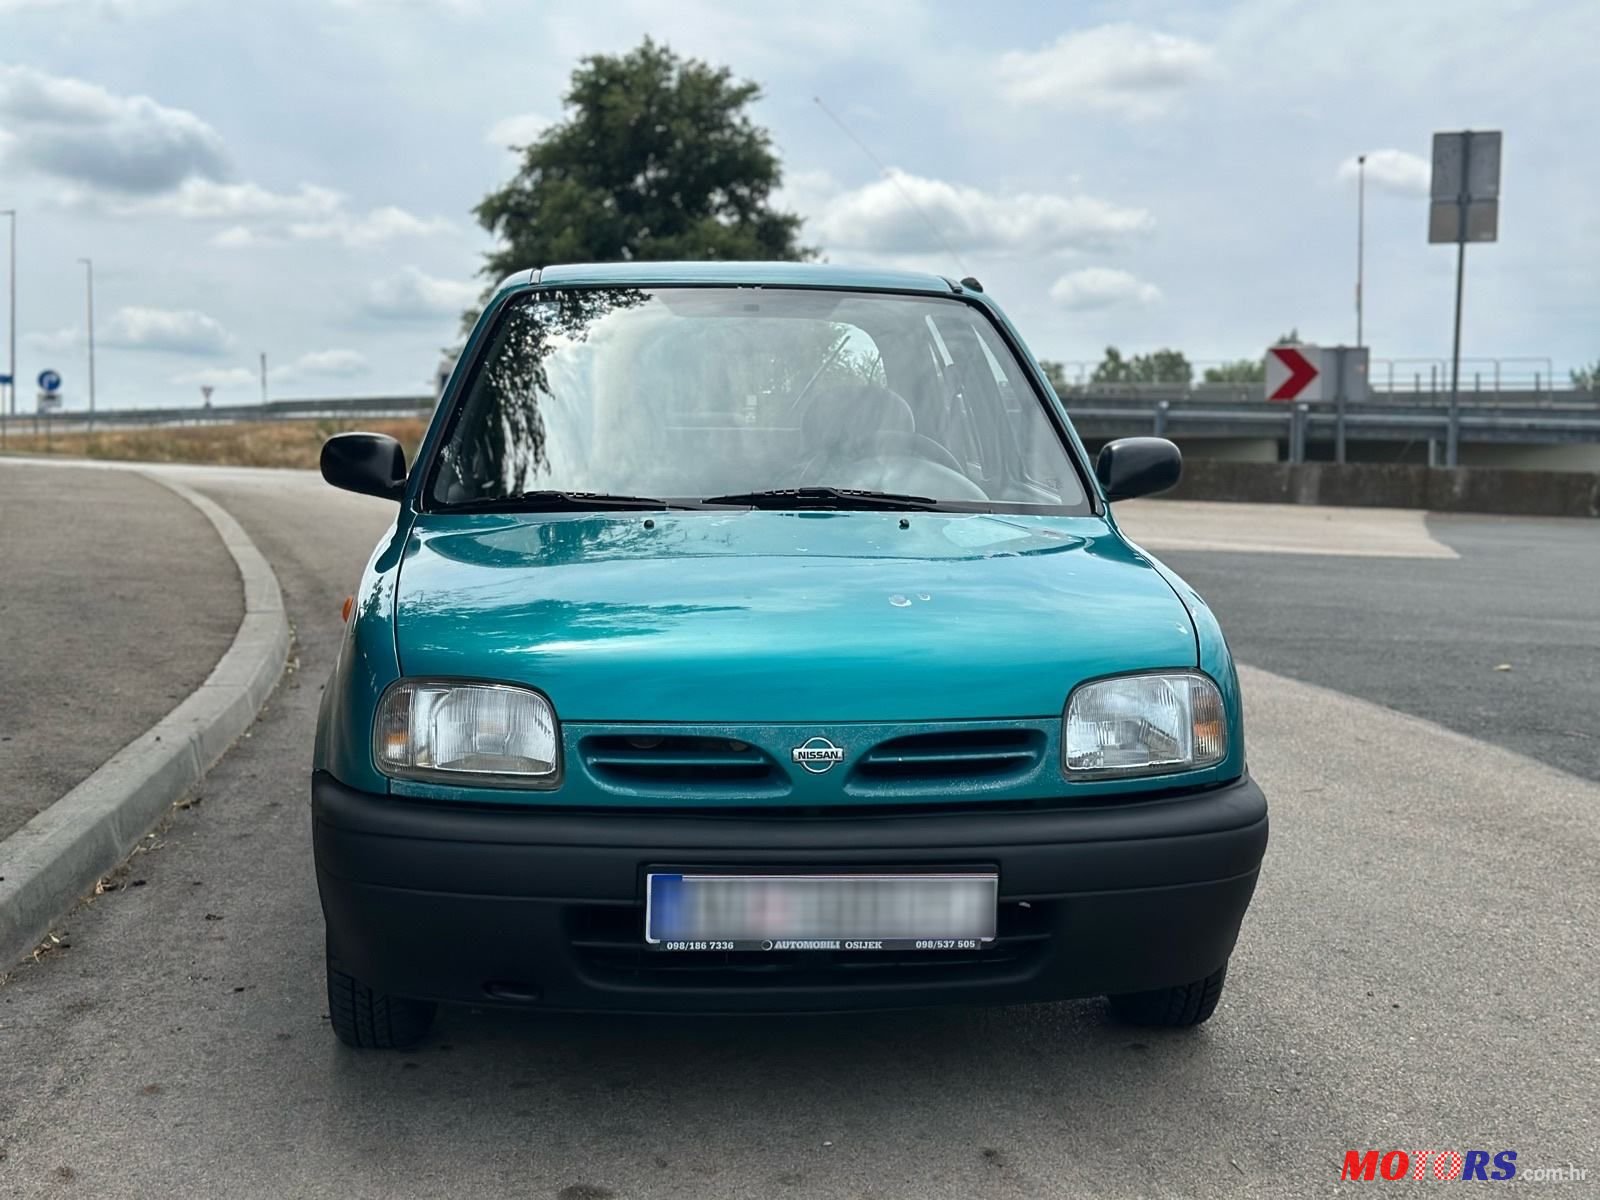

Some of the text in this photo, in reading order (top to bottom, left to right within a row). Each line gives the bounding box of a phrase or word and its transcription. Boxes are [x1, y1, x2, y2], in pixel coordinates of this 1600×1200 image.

[798, 751, 839, 760] NISSAN
[666, 941, 734, 951] 098/186 7336
[773, 940, 882, 950] AUTOMOBILI OSIJEK
[915, 940, 976, 950] 098/537 505
